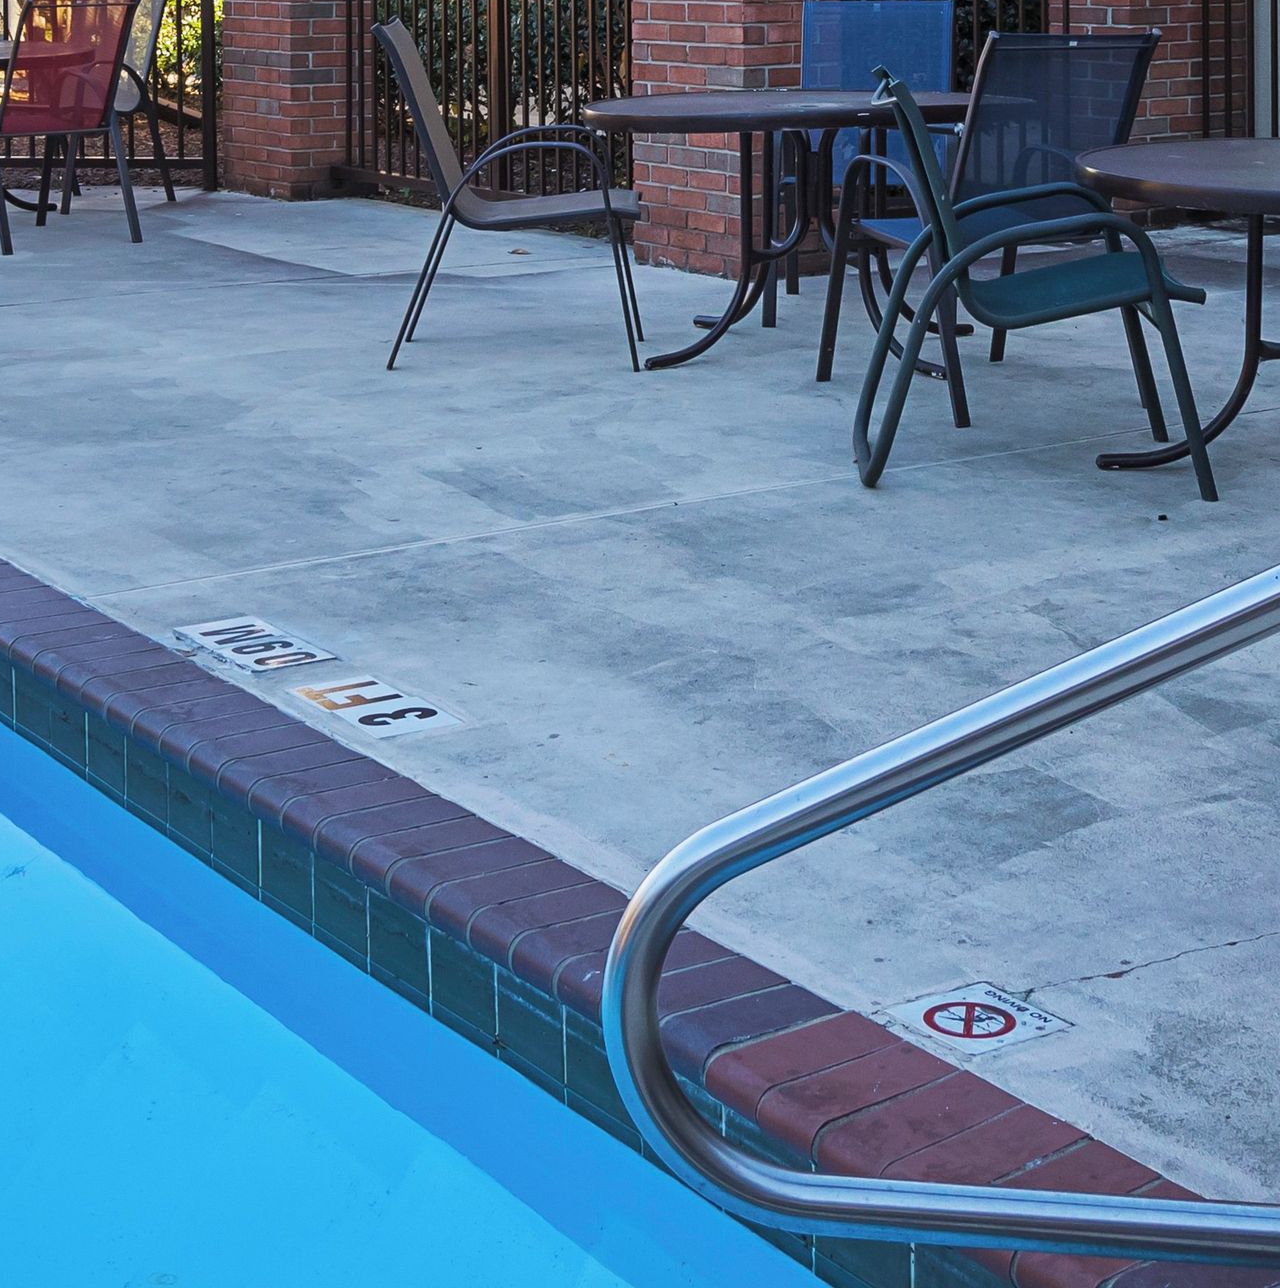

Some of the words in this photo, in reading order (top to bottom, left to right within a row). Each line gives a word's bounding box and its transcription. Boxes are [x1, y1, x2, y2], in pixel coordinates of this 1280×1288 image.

[294, 679, 404, 711] FT
[358, 706, 439, 727] 3
[984, 990, 1030, 1012] DIVING
[1029, 1012, 1054, 1024] NO
